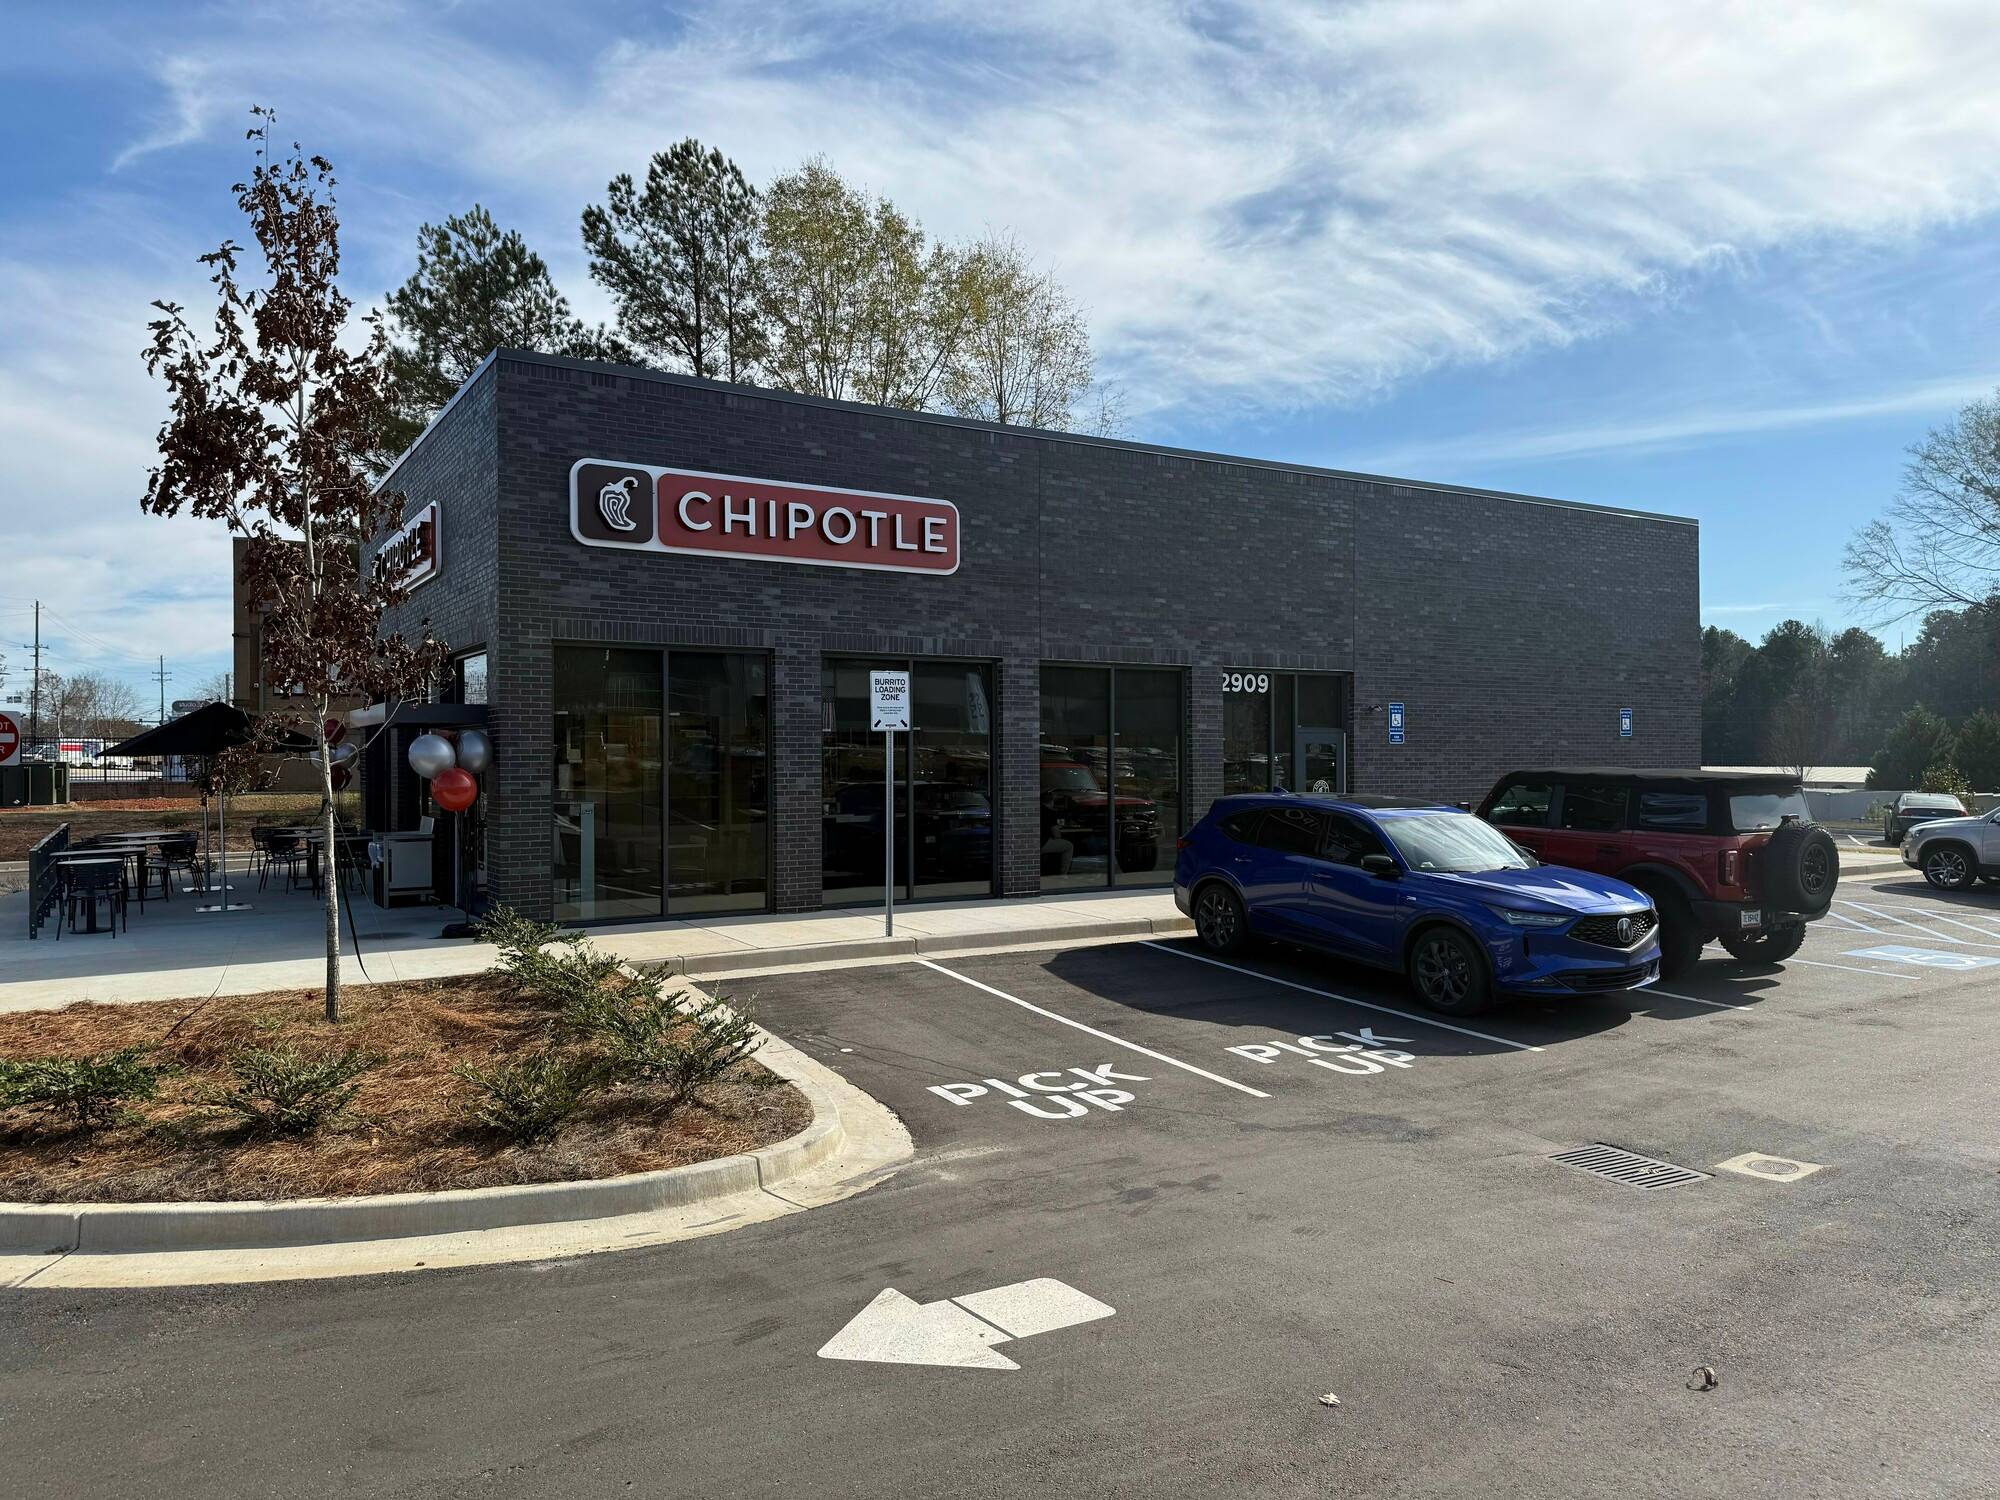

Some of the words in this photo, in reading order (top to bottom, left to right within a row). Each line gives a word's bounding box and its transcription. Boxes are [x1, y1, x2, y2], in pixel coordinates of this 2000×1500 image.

[678, 490, 948, 553] CHIPOTLE
[874, 678, 906, 686] BURRITO
[874, 686, 906, 694] LOADING
[1222, 673, 1269, 694] 2909
[880, 693, 901, 701] ZONE
[1223, 1027, 1415, 1065] PICK
[1306, 1048, 1416, 1076] UP
[925, 1062, 1153, 1107] PICK
[1006, 1088, 1136, 1120] UP
